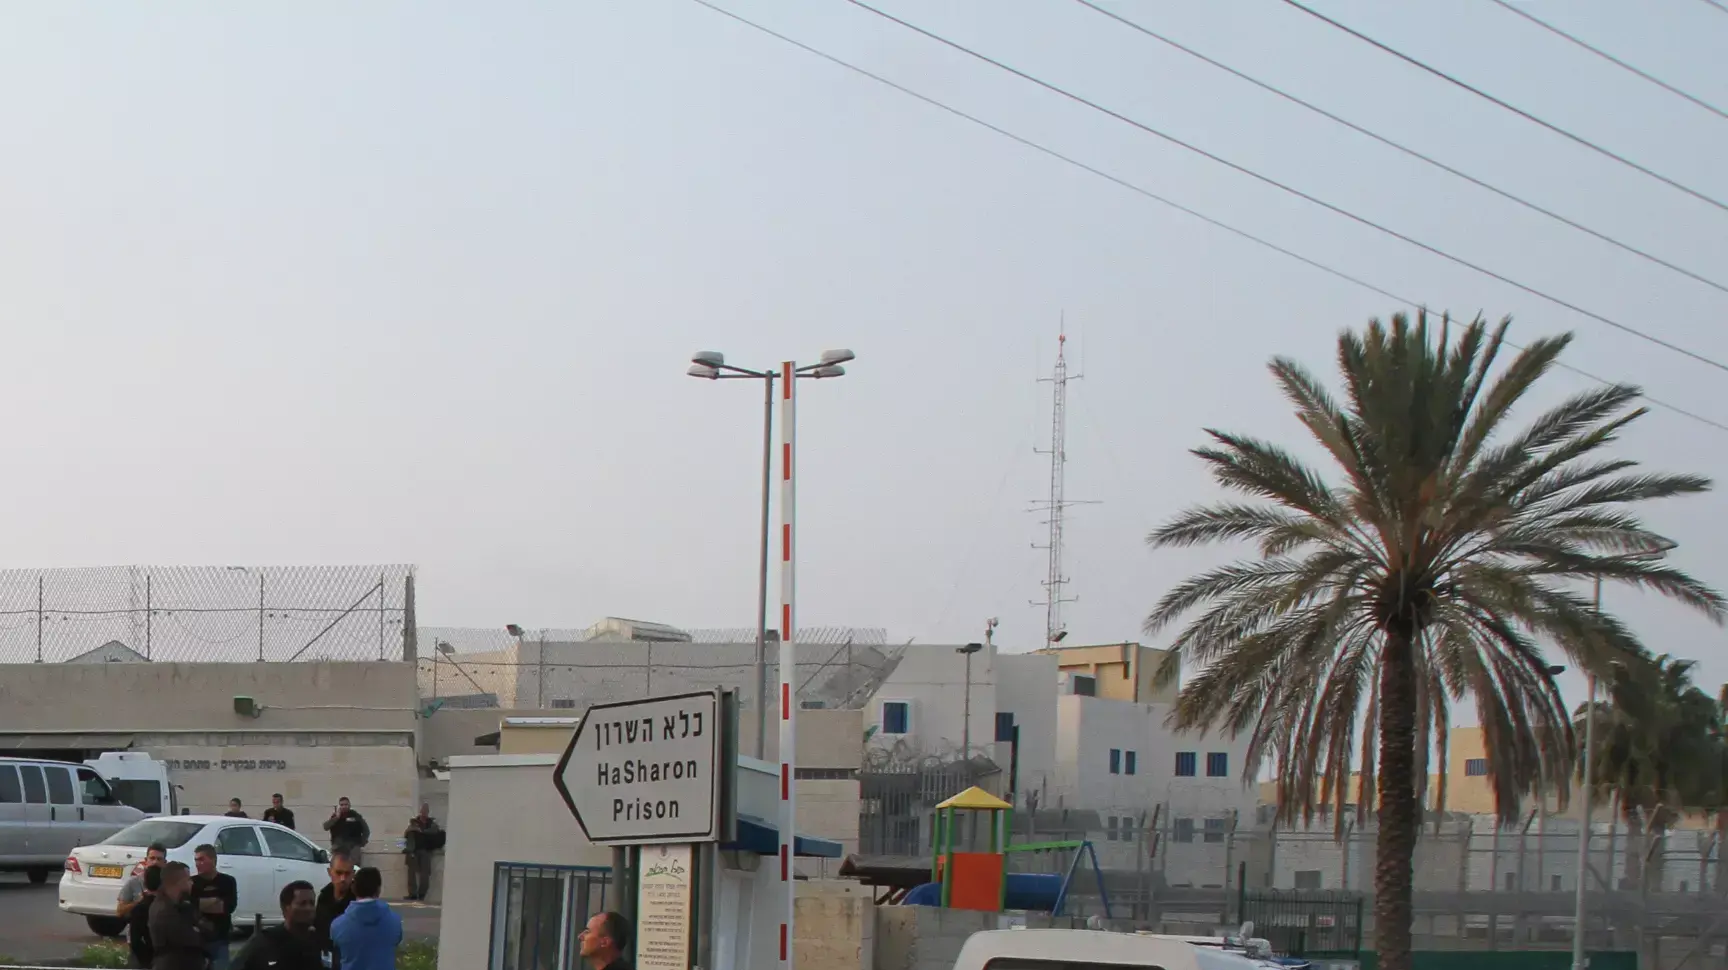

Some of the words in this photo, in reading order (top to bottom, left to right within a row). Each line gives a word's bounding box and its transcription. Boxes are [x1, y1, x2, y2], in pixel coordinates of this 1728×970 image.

[594, 718, 654, 751] השרון
[663, 709, 703, 741] כלא
[597, 759, 698, 786] HaSharon
[612, 797, 679, 822] Prison
